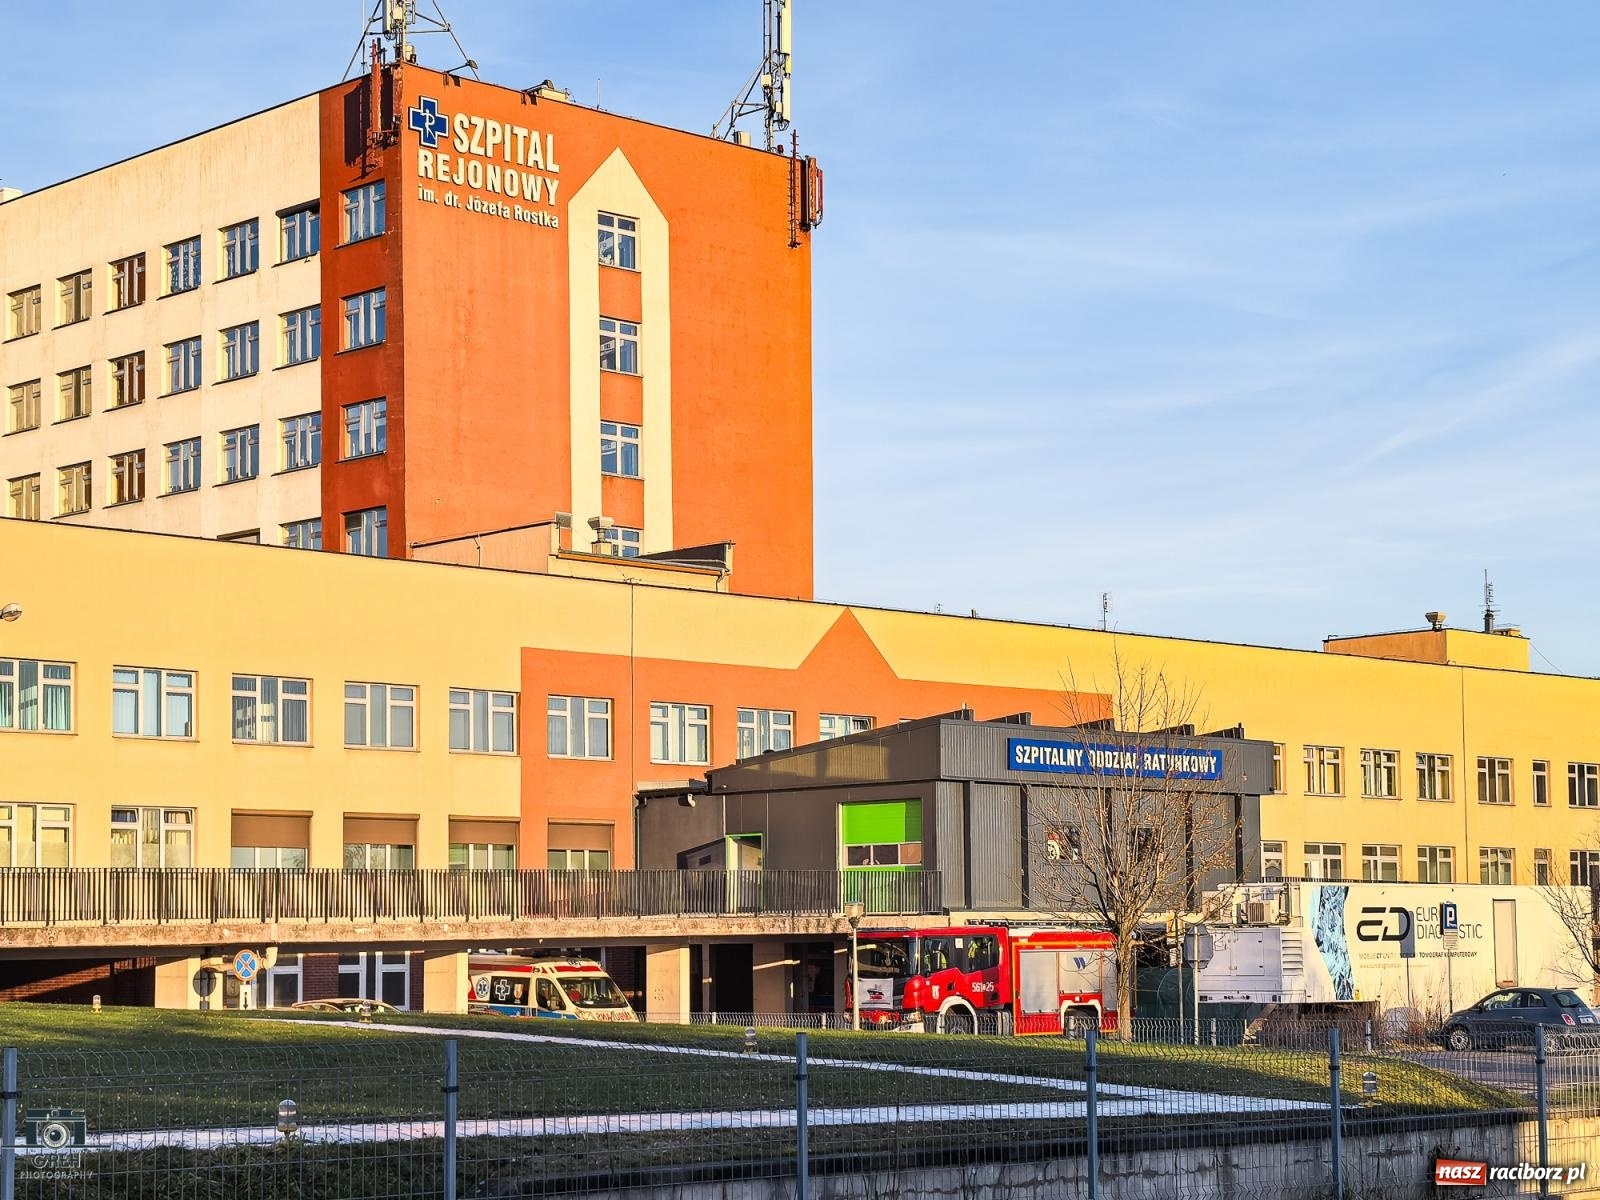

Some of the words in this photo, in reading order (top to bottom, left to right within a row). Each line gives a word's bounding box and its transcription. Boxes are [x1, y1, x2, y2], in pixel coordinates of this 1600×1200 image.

[453, 112, 560, 173] SZPITAL
[418, 149, 560, 206] REJONOWY
[418, 184, 438, 204] im.
[444, 190, 462, 209] dr.
[466, 194, 511, 220] Józefa
[514, 206, 559, 229] Rostka
[1015, 744, 1083, 767] SZPITALNY
[1144, 753, 1217, 774] RATUNKOWY
[1416, 906, 1440, 922] EUR
[1416, 924, 1483, 939] DIAGSTIC
